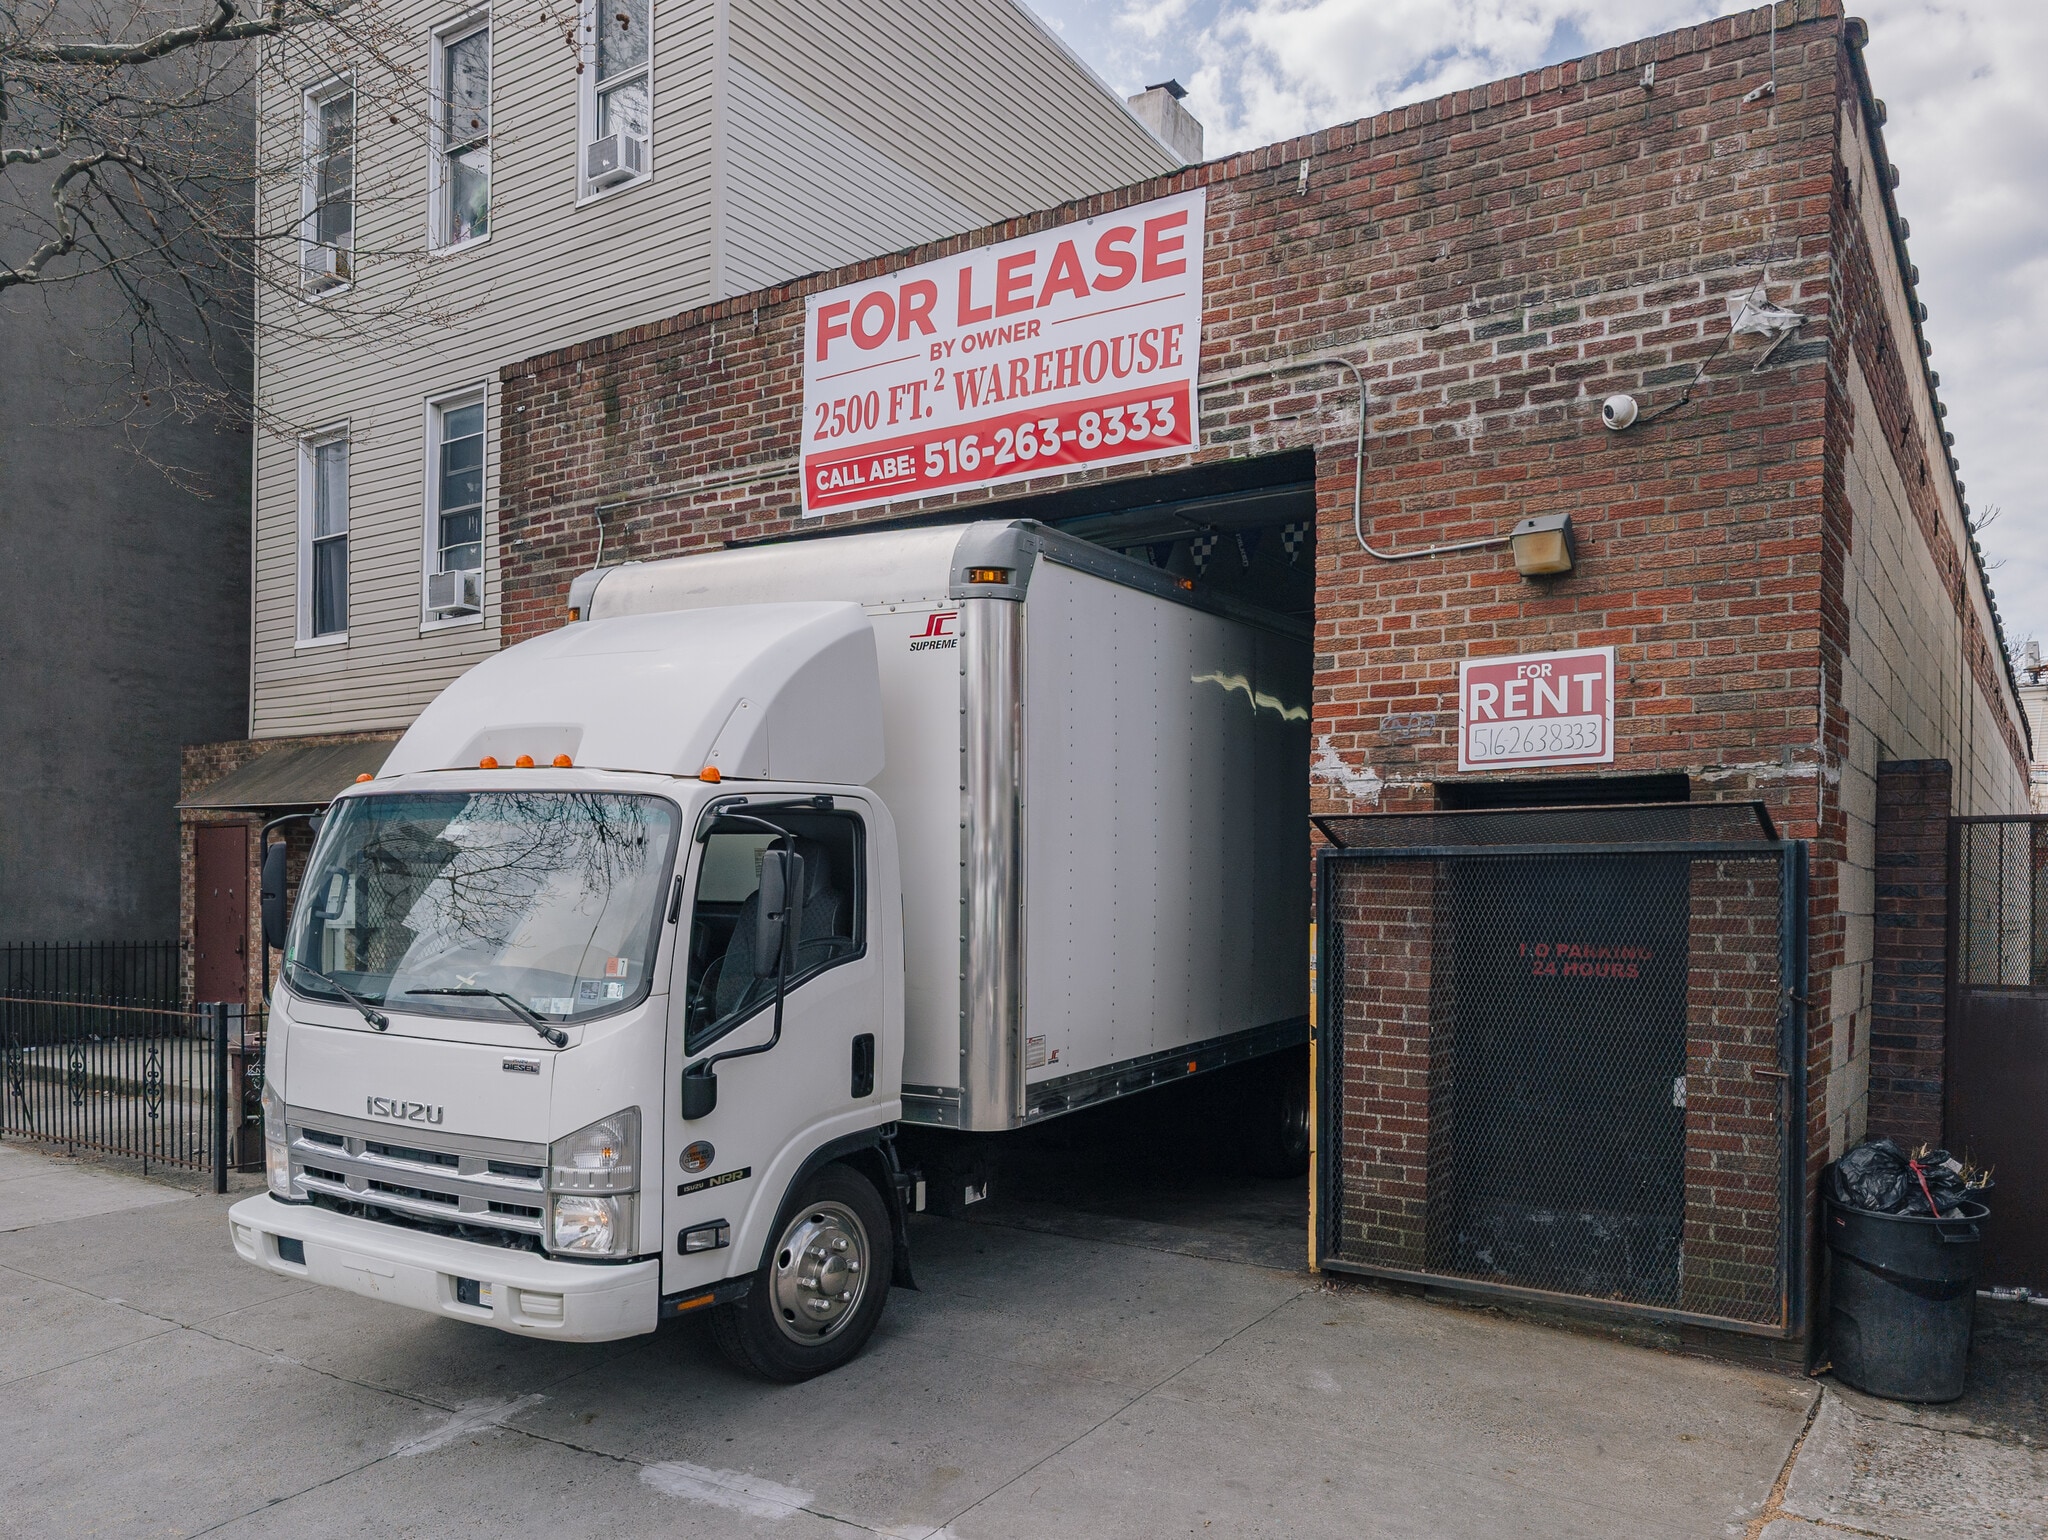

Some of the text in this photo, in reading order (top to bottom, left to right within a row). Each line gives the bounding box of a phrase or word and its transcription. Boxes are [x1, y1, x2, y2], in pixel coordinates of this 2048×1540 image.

[816, 210, 1189, 362] FOR LEASE
[929, 319, 1041, 361] BY OWNER
[813, 390, 879, 441] 2500
[953, 323, 1184, 411] WAREHOUSE
[815, 397, 1176, 490] CALL ABE: 516-263-8333
[909, 639, 958, 652] SUPREME
[1517, 663, 1552, 679] FOR
[1470, 672, 1602, 721] RENT
[1532, 961, 1639, 978] 24 HOURS
[503, 1063, 537, 1073] DIESEL
[367, 1096, 443, 1124] ISUZU
[684, 1170, 744, 1192] ISUZU NRR
